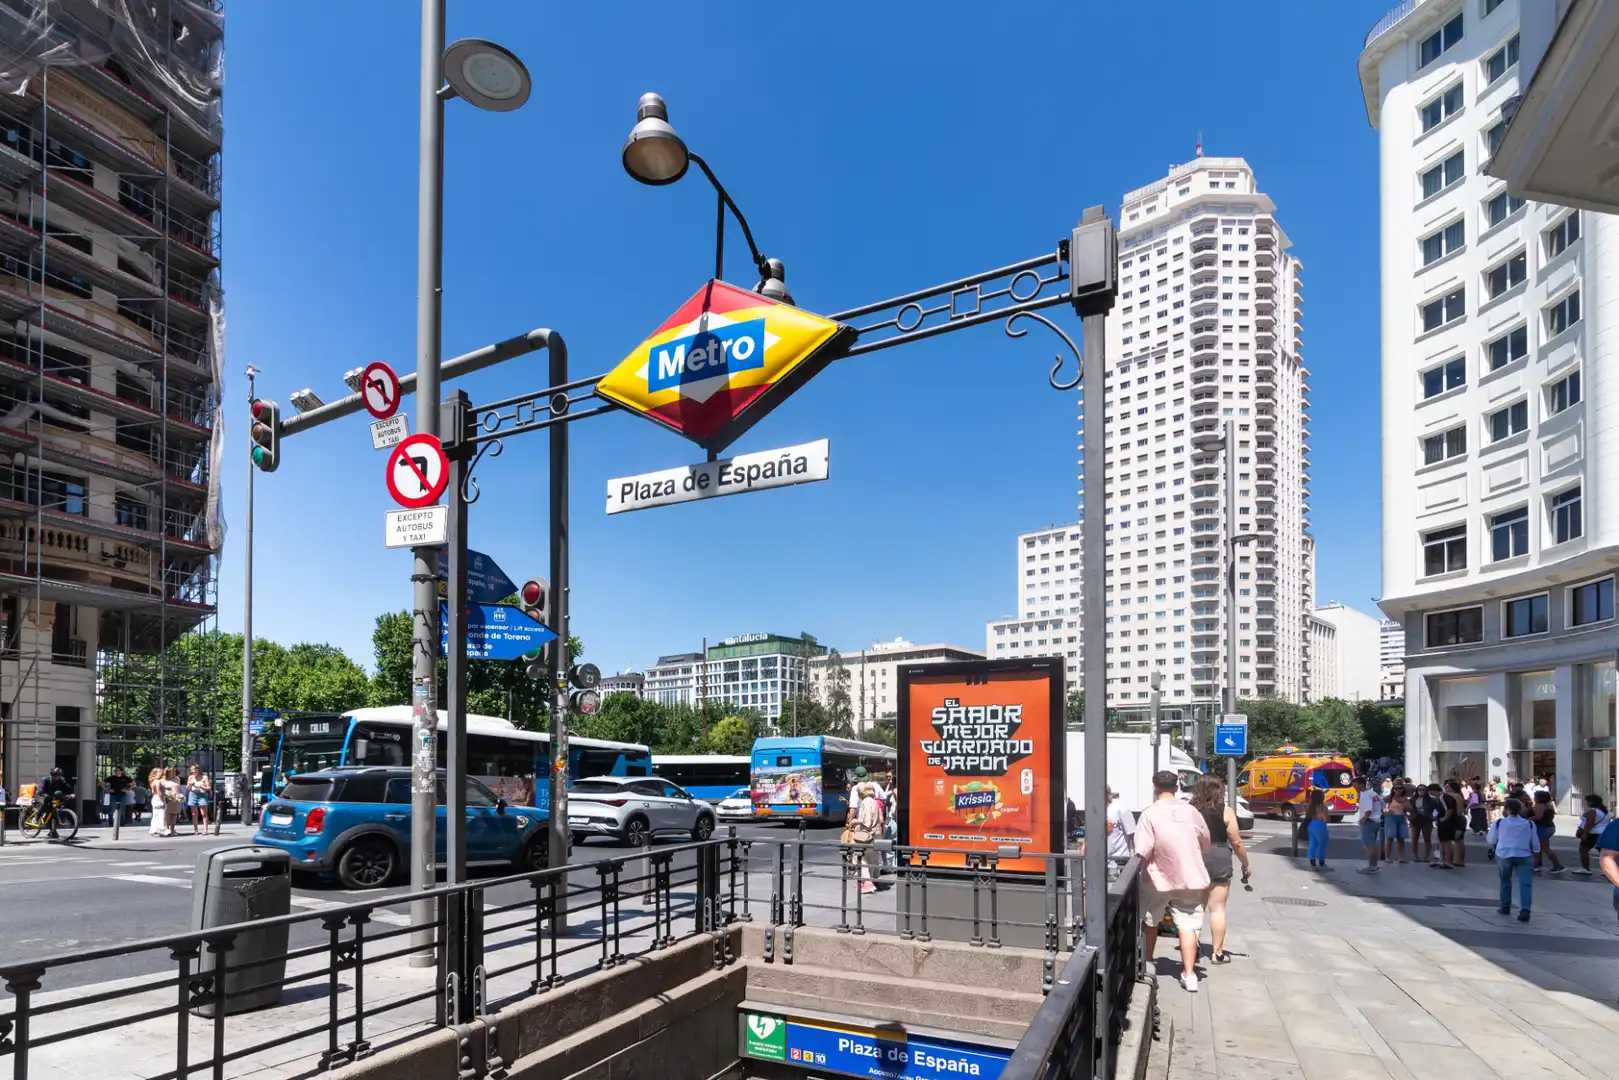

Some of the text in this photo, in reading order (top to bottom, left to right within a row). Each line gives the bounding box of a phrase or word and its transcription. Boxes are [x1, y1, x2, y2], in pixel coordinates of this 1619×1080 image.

[658, 335, 755, 380] Metro
[375, 418, 399, 430] EXCEPTO
[377, 427, 401, 438] AUTOBUS
[620, 453, 808, 503] Plaza de España
[397, 511, 433, 522] EXCEPTO
[396, 522, 433, 532] AUTOBUS
[410, 533, 426, 541] TAXI
[503, 633, 531, 641] Toreno
[944, 699, 959, 707] EL
[931, 704, 1023, 725] SABOR
[291, 724, 300, 735] 44
[942, 724, 1008, 739] MEJOR
[919, 739, 1034, 754] GUARDADO
[927, 752, 1008, 770] DE JAPÓN
[958, 794, 992, 806] Krissia
[815, 1054, 826, 1064] 10
[838, 1038, 980, 1076] Plaza de España
